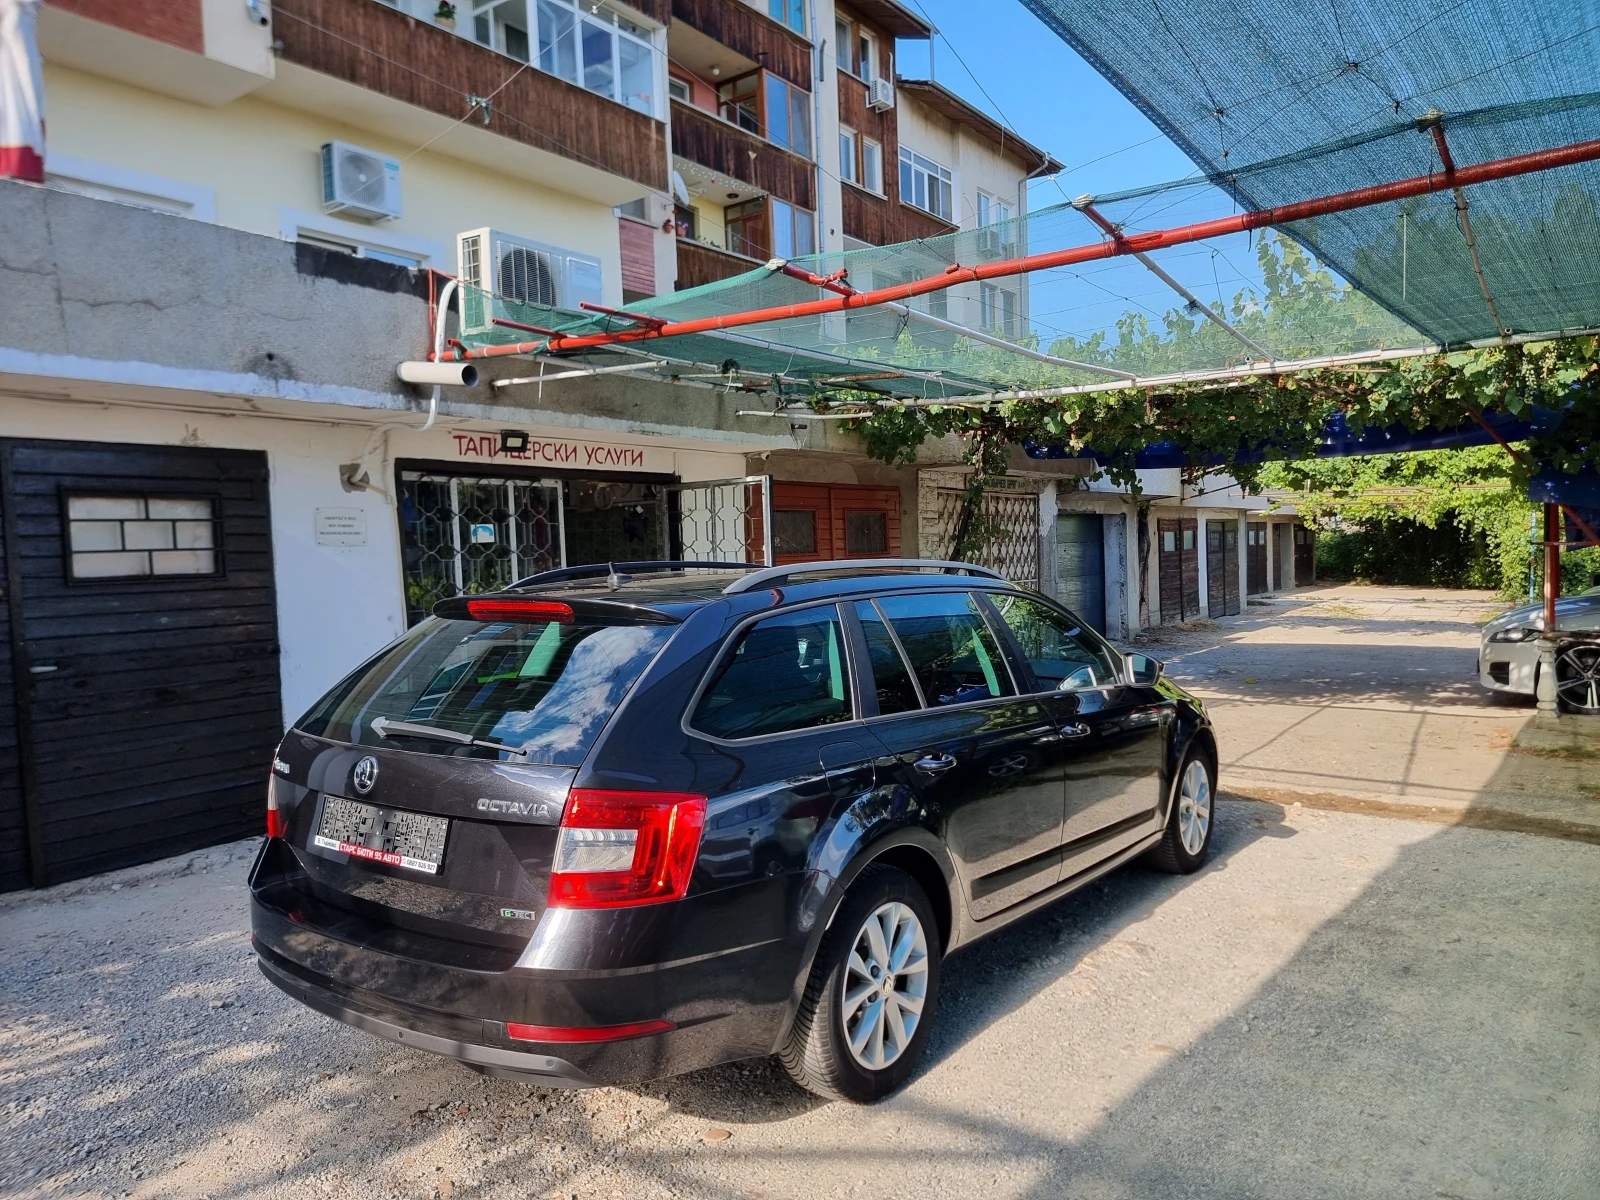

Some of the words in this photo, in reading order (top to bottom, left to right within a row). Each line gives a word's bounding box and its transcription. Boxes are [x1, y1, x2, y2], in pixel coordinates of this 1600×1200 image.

[584, 446, 643, 467] УСЛУГИ
[476, 797, 551, 818] OCTAVIA
[339, 843, 356, 853] СТАРС
[357, 847, 374, 857] БЮТИ
[374, 851, 382, 860] 95
[383, 854, 400, 864] АВТО
